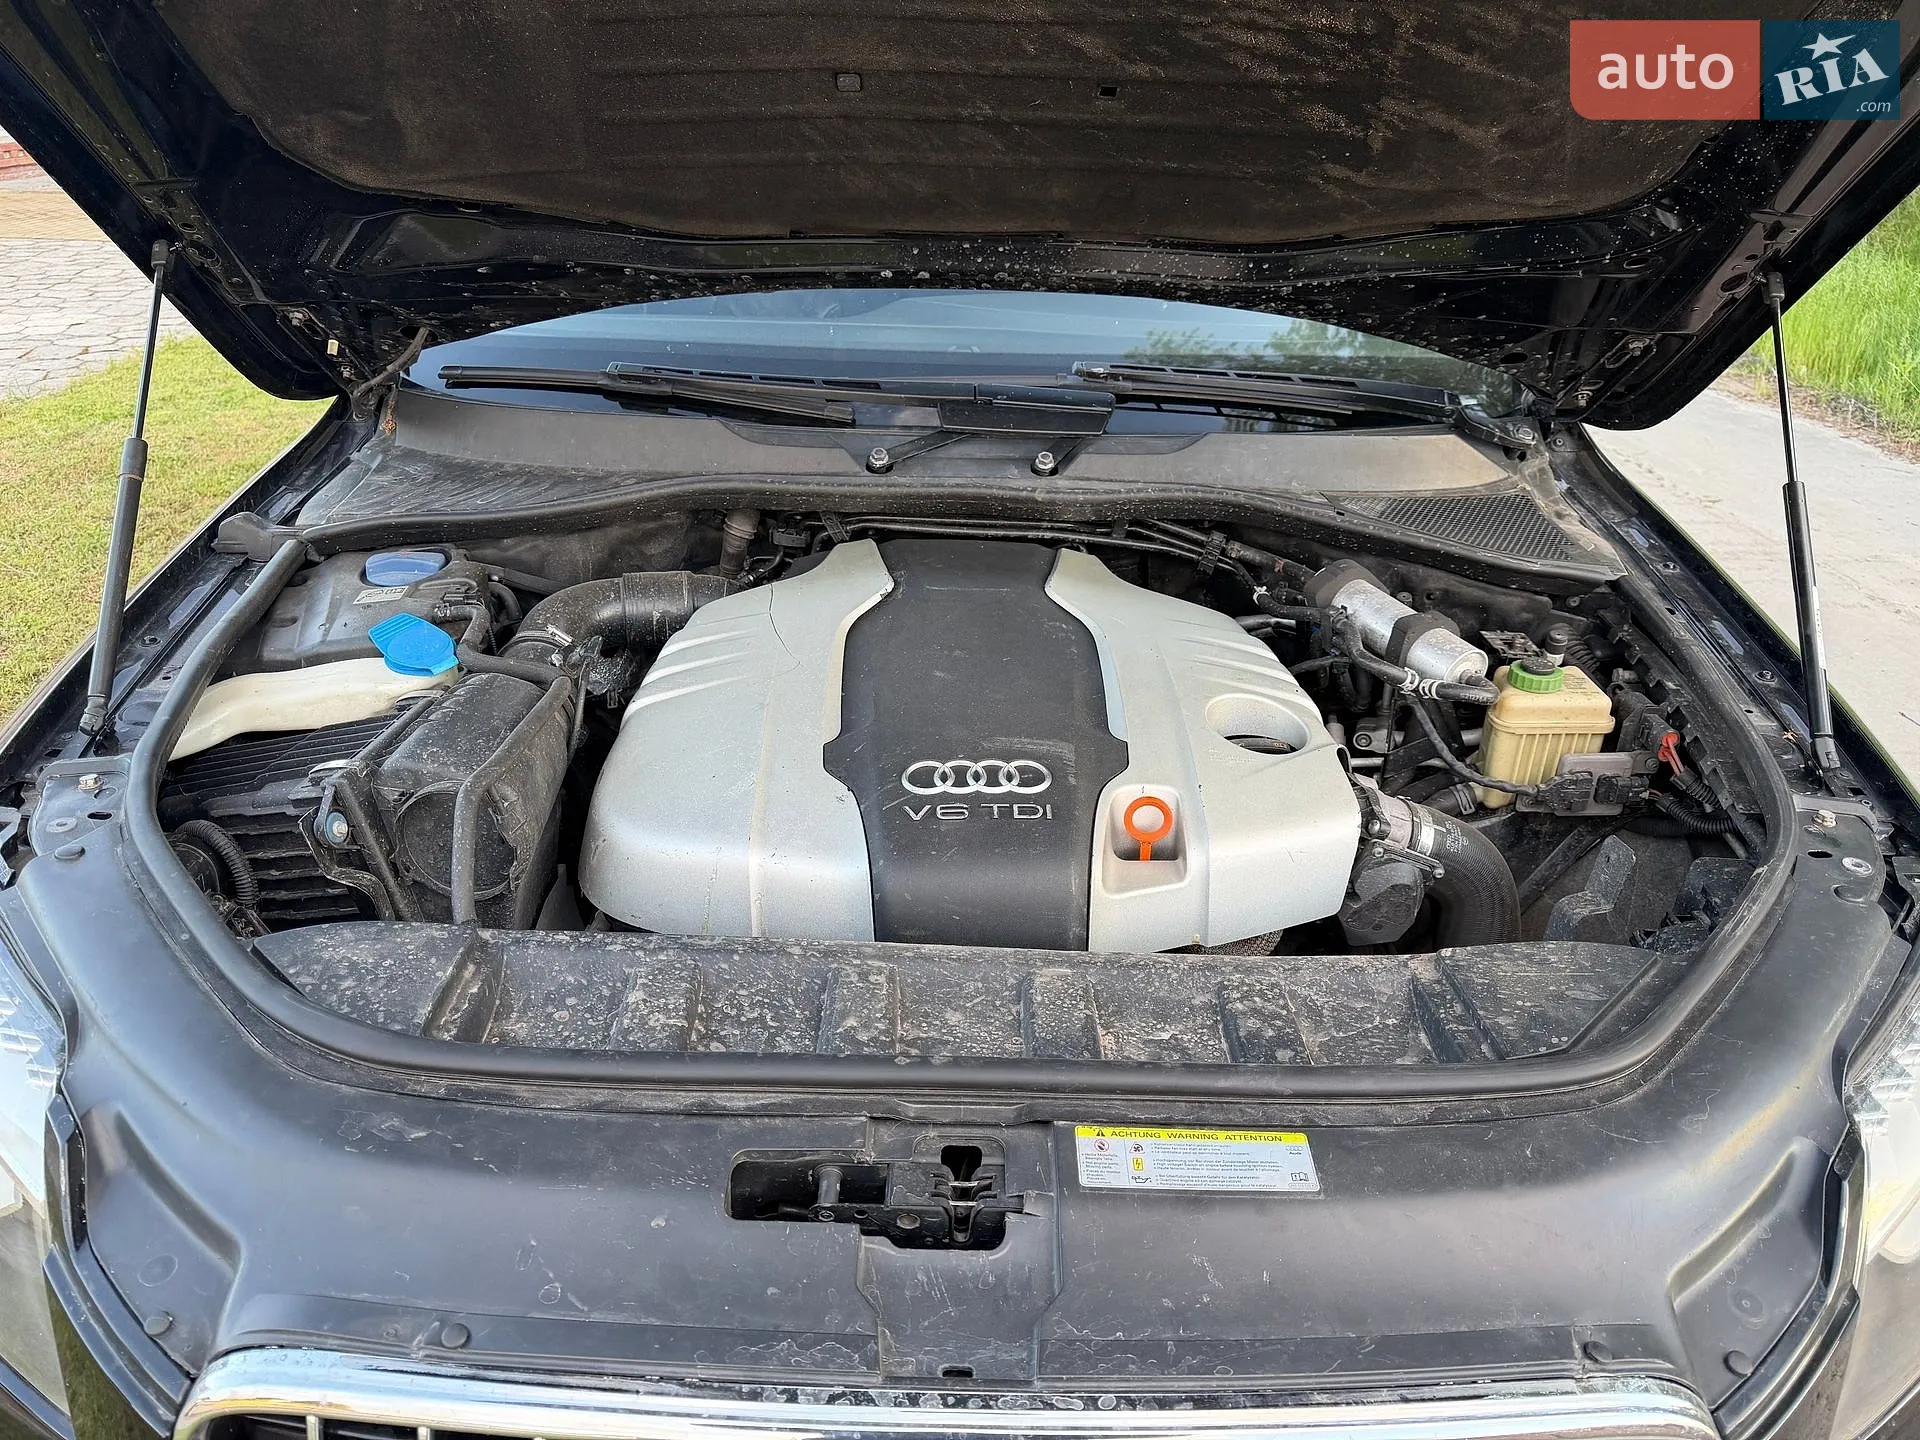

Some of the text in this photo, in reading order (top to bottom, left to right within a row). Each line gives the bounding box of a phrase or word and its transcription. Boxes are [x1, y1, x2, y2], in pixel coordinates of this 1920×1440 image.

[902, 803, 1053, 821] V6 TDI
[1110, 1131, 1283, 1142] ACHTUNG WARNING ATTENTION
